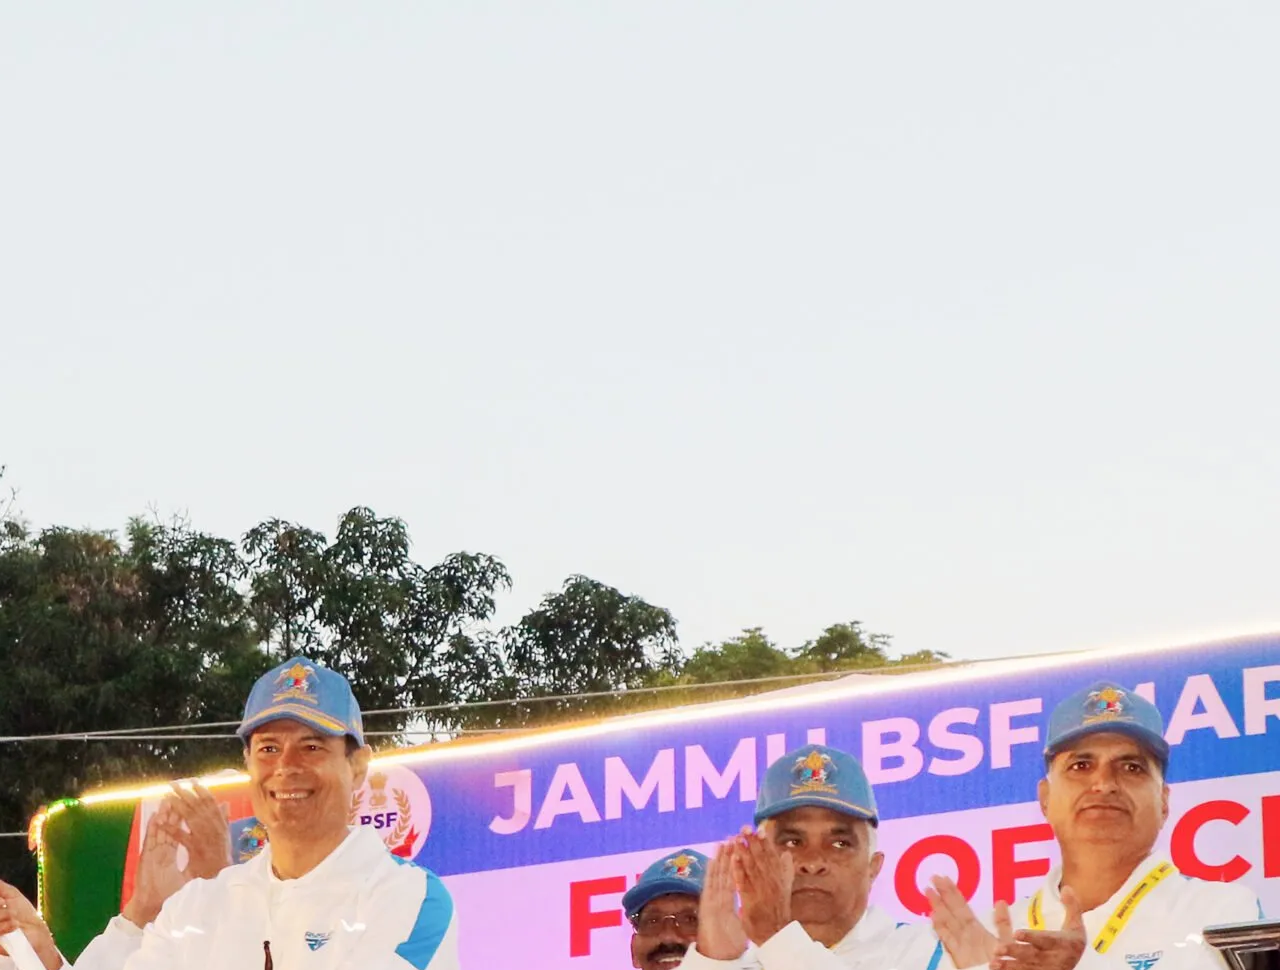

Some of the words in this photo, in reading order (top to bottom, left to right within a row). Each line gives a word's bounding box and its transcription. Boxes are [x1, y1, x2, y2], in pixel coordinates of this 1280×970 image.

[861, 698, 1043, 786] BSF
[1135, 665, 1280, 746] AR
[360, 812, 397, 829] BSF
